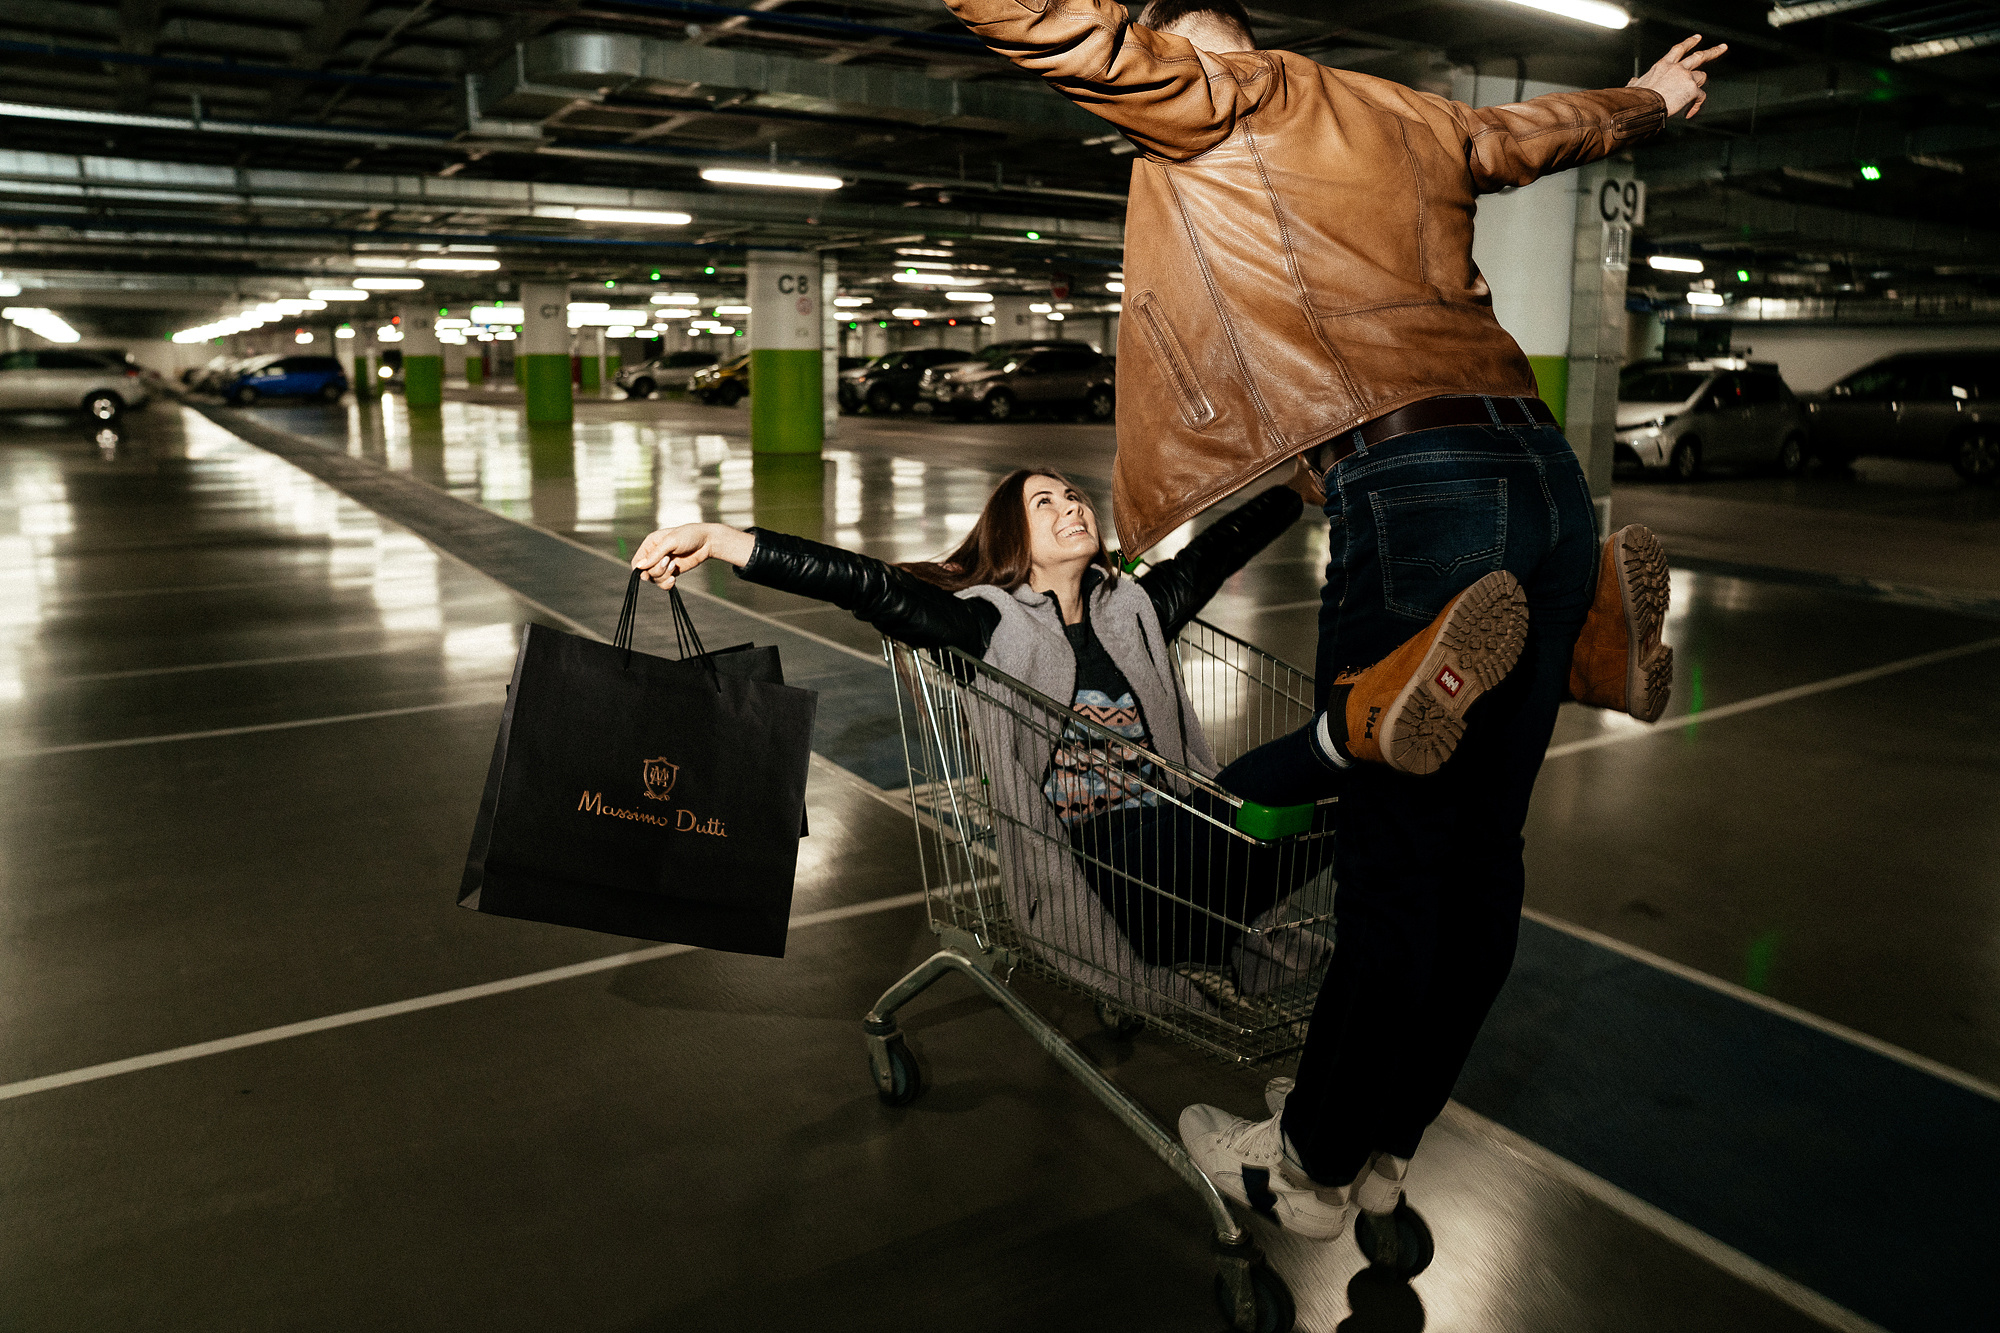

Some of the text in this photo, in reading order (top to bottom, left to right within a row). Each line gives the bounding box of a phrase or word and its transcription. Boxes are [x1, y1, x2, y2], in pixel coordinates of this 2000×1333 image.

[1599, 179, 1638, 222] C9
[778, 274, 809, 295] C8
[540, 303, 561, 319] C7
[1440, 670, 1460, 692] HH
[577, 790, 728, 838] Massimo Dutti
